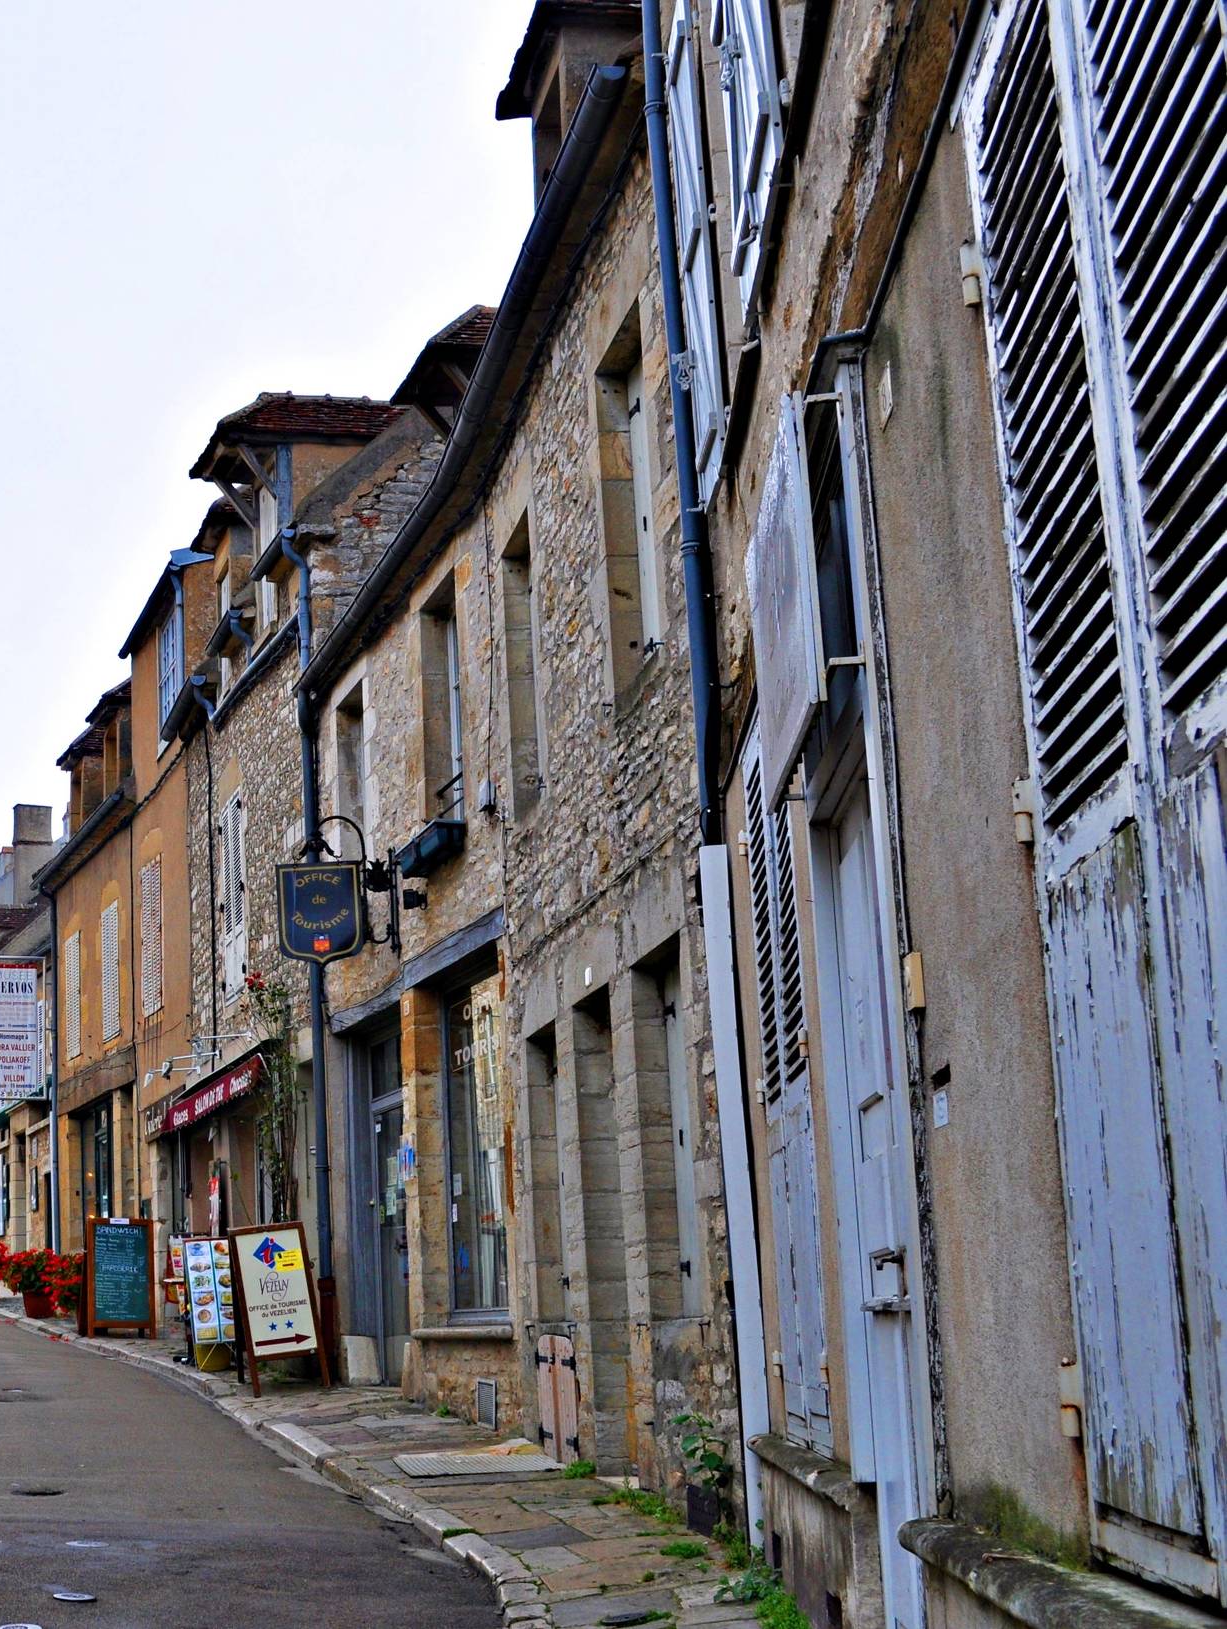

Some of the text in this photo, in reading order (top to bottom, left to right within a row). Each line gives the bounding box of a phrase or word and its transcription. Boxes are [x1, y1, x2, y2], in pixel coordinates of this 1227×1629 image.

[294, 872, 342, 888] OFFICE
[311, 894, 327, 905] de
[291, 906, 350, 930] Tourisme
[0, 1033, 25, 1041] Hommage
[10, 1043, 36, 1051] VALLIER
[3, 1074, 26, 1082] VILLON
[194, 1091, 210, 1116] SALON
[248, 1303, 270, 1313] OFFICE
[278, 1299, 308, 1309] TOURISME
